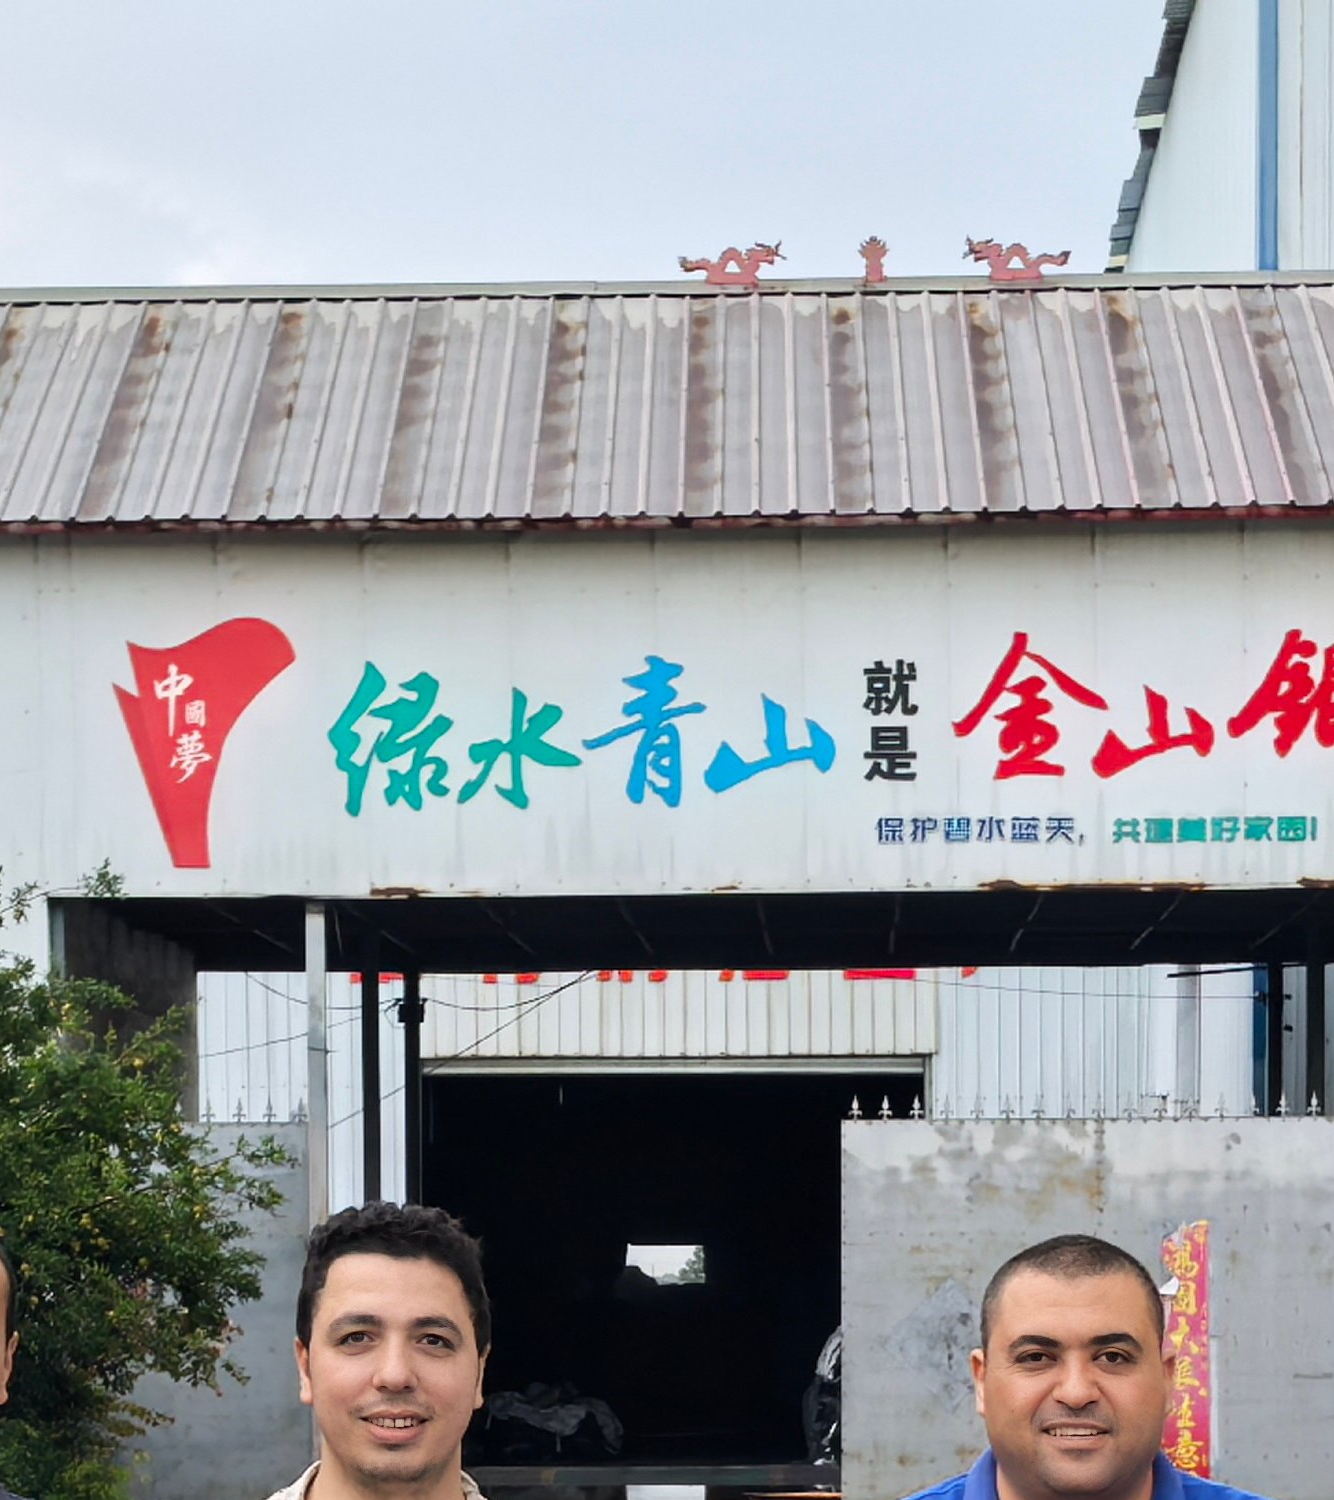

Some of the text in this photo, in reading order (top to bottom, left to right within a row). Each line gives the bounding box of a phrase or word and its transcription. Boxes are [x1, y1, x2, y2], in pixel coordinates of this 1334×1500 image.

[153, 664, 213, 783] 中國夢
[328, 656, 836, 816] 绿水青山
[864, 660, 918, 781] 就是
